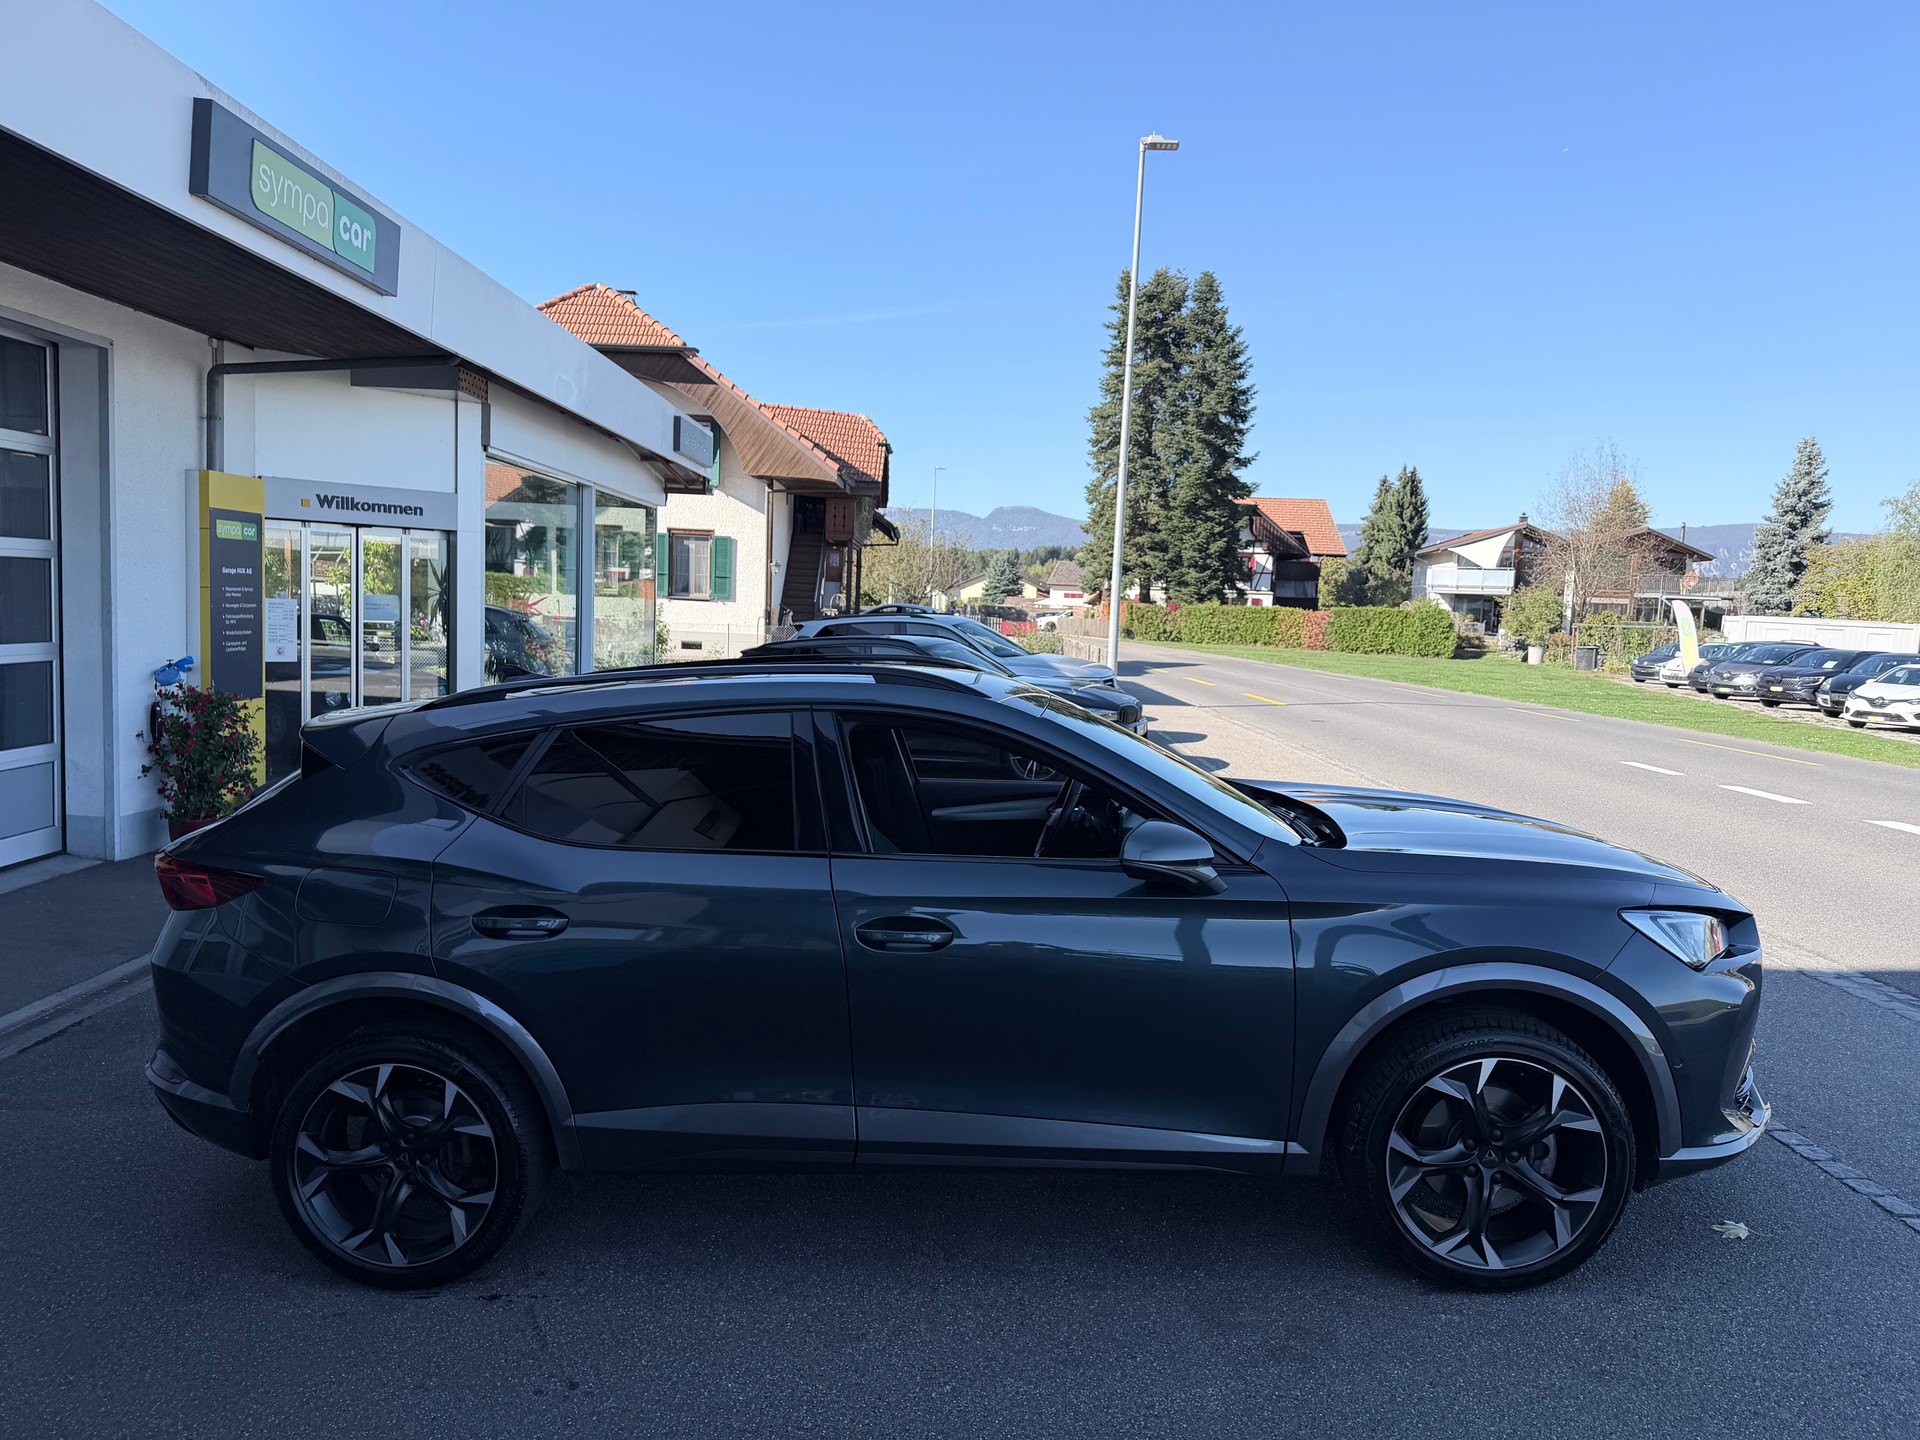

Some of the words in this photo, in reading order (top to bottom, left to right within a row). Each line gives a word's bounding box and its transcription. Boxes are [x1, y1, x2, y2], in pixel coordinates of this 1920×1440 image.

[258, 163, 329, 229] sympa
[339, 215, 372, 252] car
[316, 494, 424, 516] Willkommen
[218, 525, 241, 536] sympa
[243, 527, 256, 536] car
[222, 566, 236, 575] Garage
